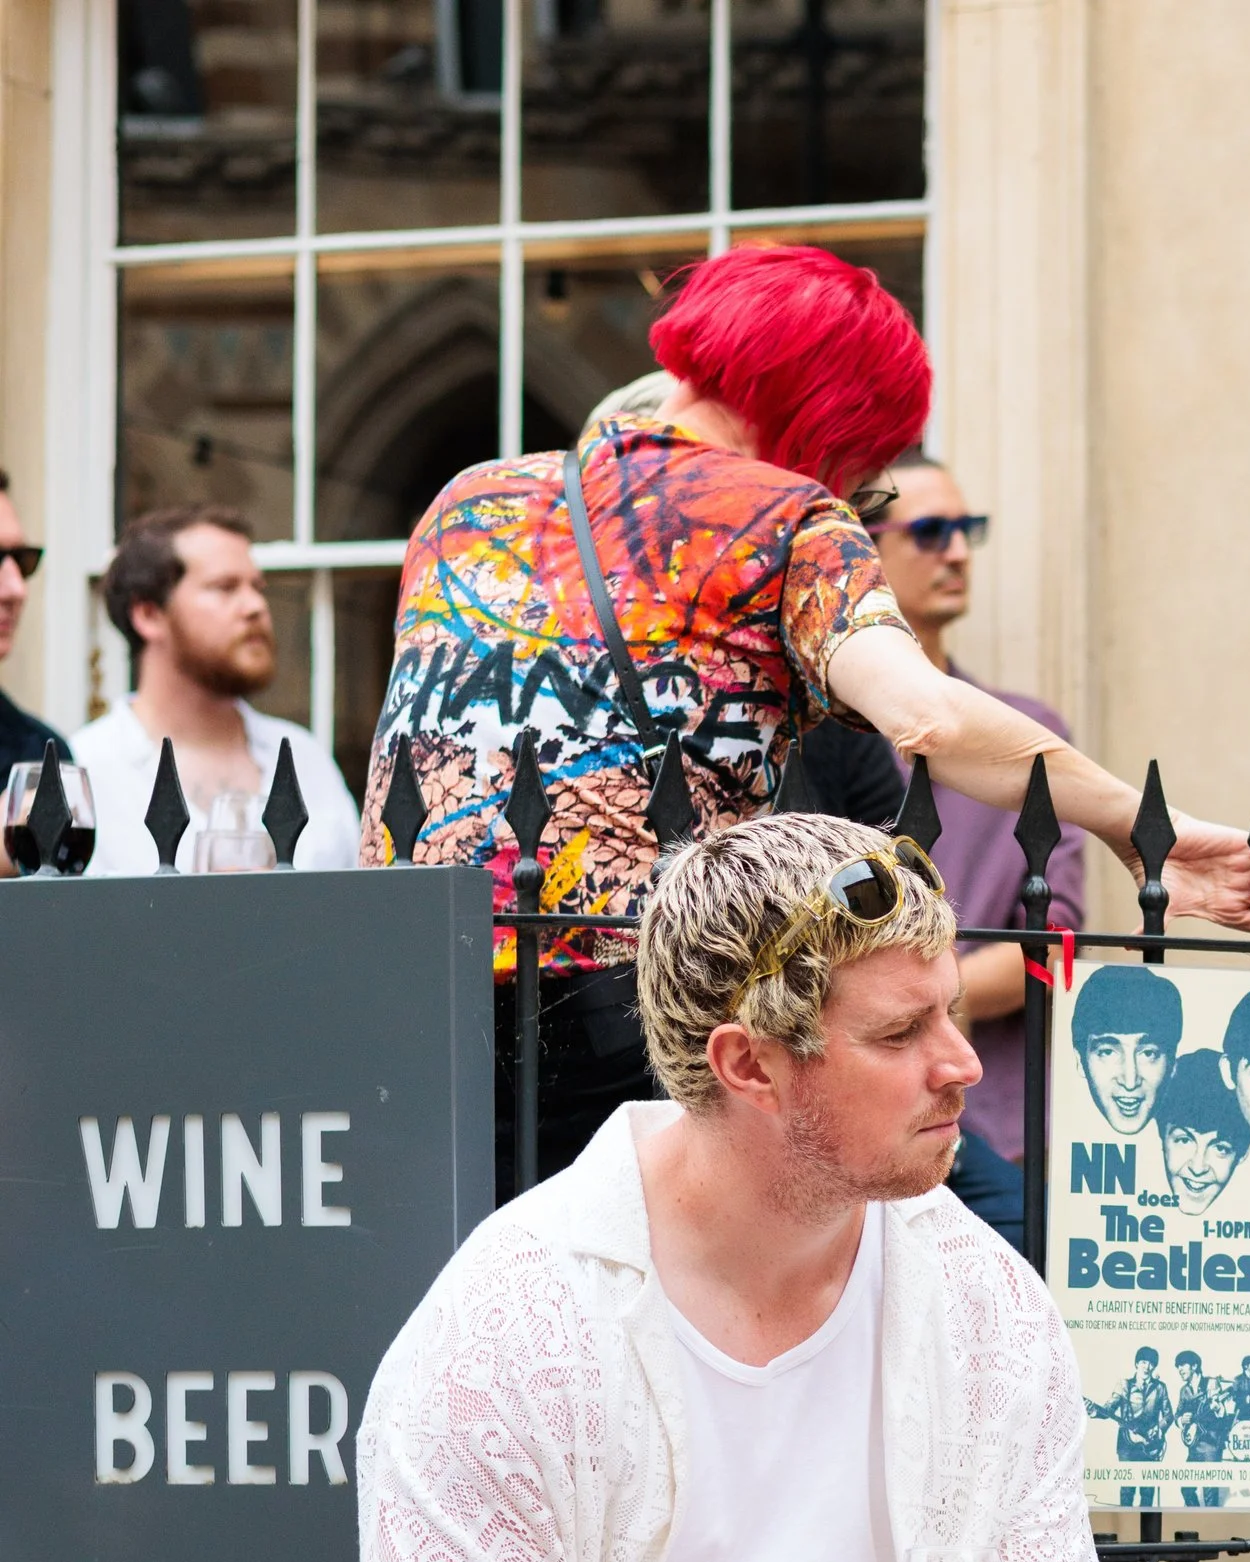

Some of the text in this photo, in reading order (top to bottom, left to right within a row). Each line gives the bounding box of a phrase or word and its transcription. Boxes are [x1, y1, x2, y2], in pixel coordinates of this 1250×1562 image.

[78, 1111, 352, 1229] WINE
[1069, 1142, 1136, 1195] NN
[1137, 1189, 1180, 1208] does
[1100, 1204, 1165, 1243] The
[1087, 1300, 1094, 1313] A
[1096, 1300, 1134, 1314] CHARITY
[1136, 1301, 1163, 1314] EVENT
[1165, 1301, 1214, 1315] BENEFITING
[1216, 1302, 1230, 1316] THE
[1085, 1319, 1117, 1330] TOGETHER
[1118, 1320, 1128, 1330] AN
[1128, 1320, 1157, 1331] ECLECTIC
[1158, 1321, 1179, 1331] GROUP
[1180, 1321, 1189, 1331] OF
[1189, 1321, 1235, 1333] NORTHAMPTON
[93, 1371, 349, 1486] BEER
[1093, 1468, 1112, 1480] JULY
[1141, 1468, 1170, 1481] VANDB
[1239, 1469, 1248, 1481] 10
